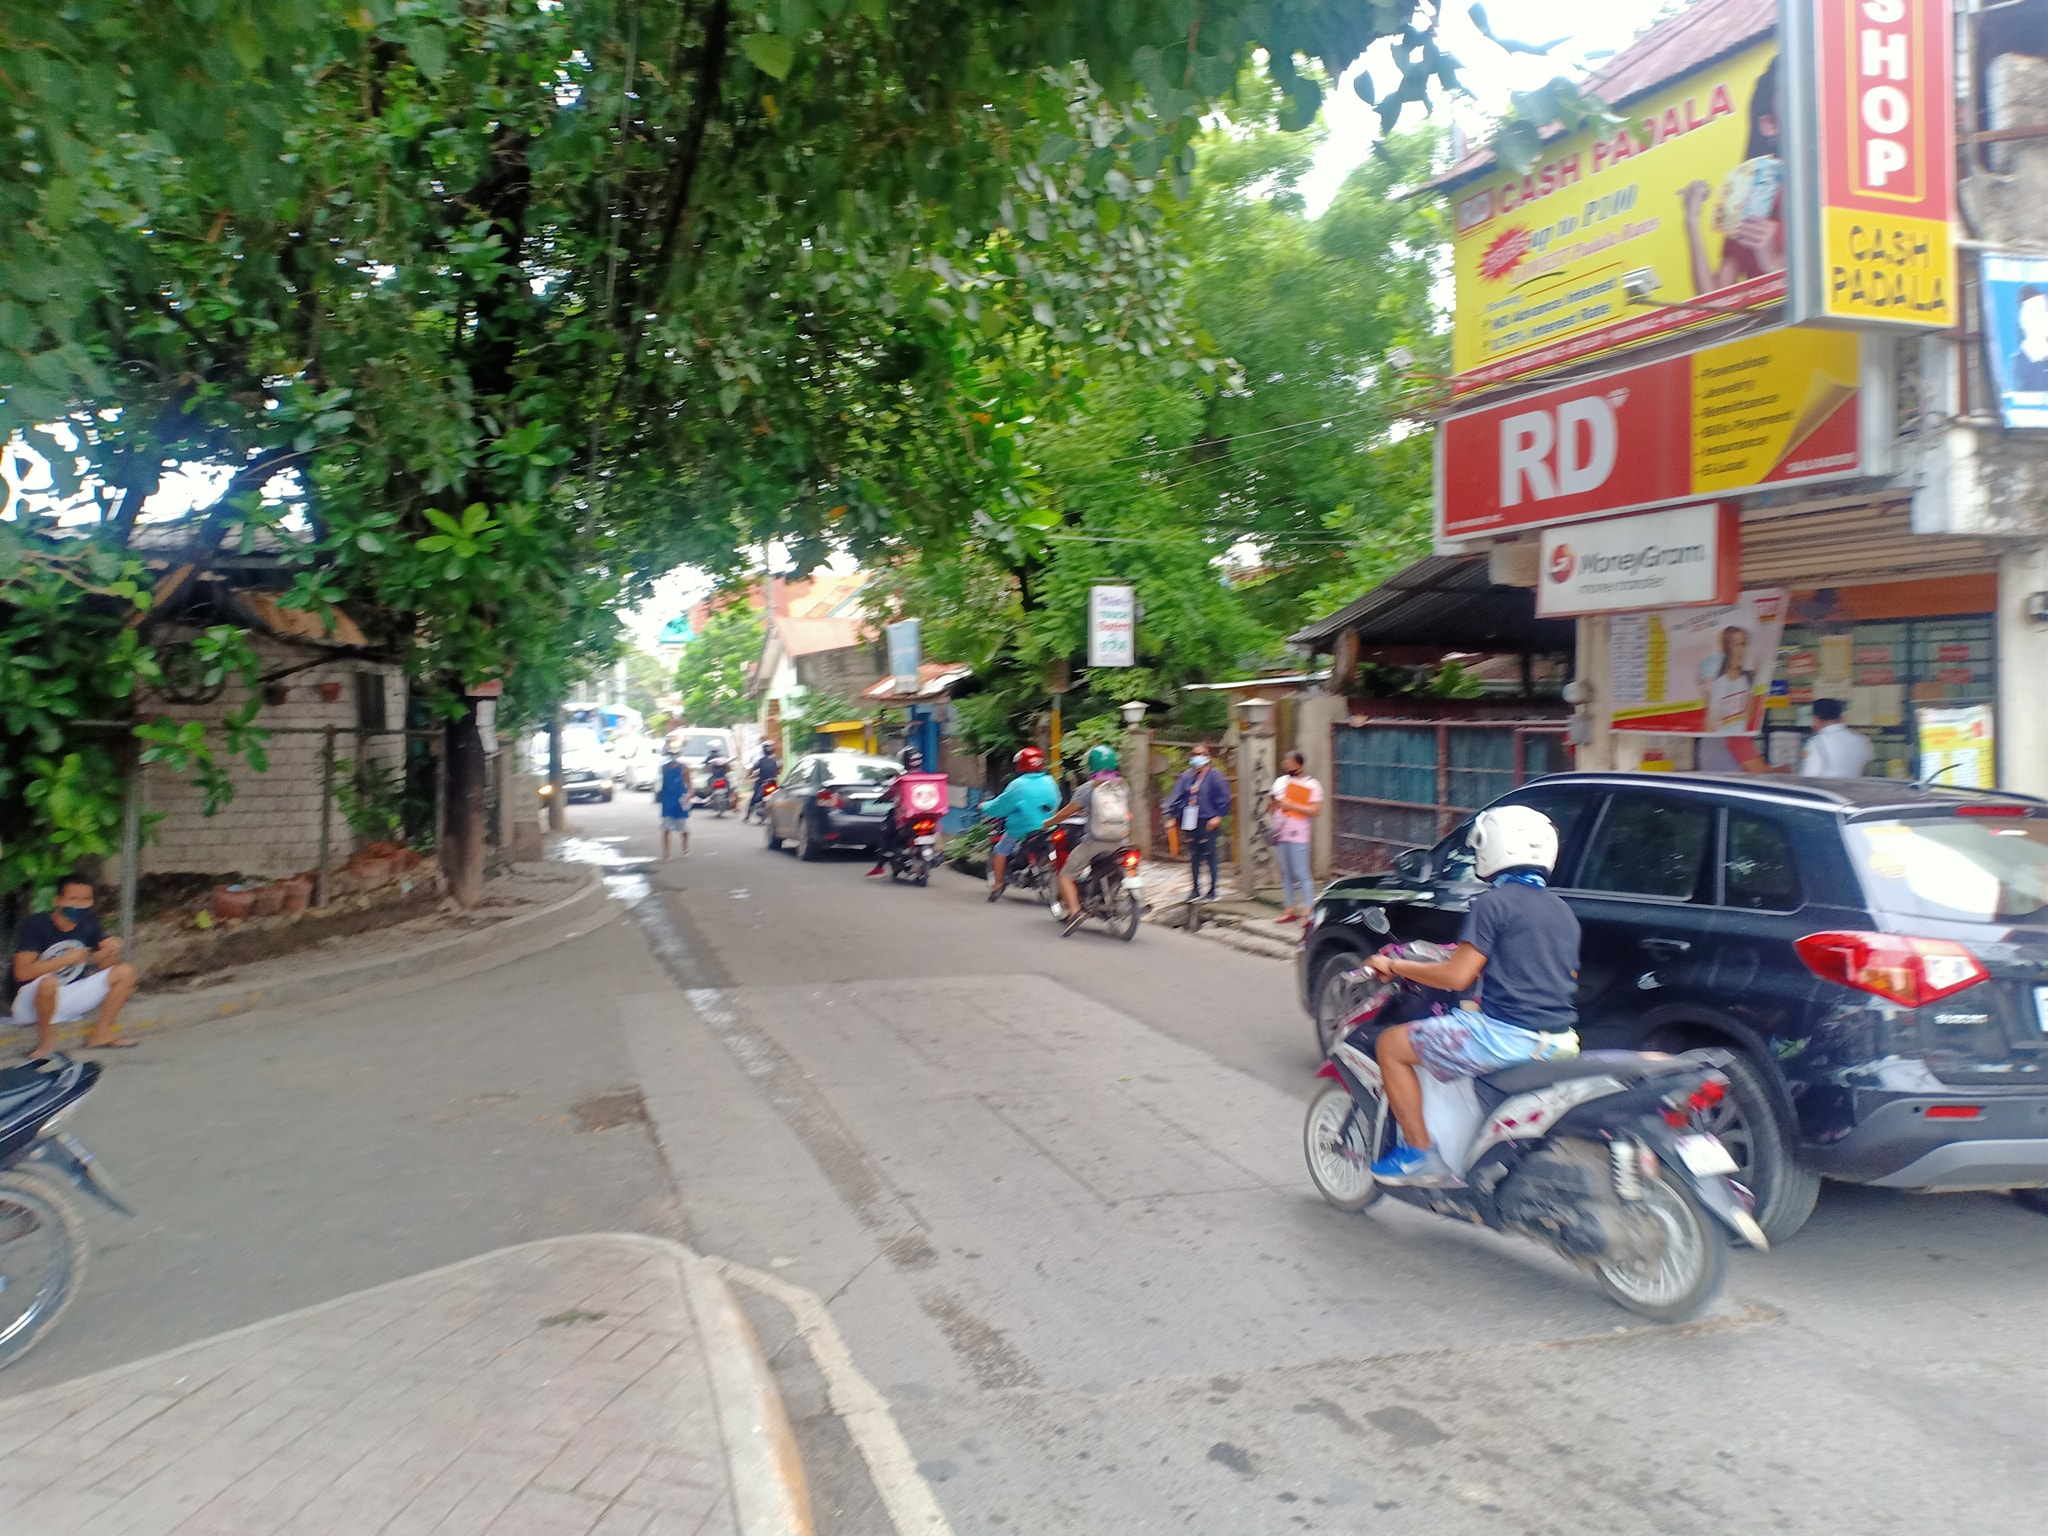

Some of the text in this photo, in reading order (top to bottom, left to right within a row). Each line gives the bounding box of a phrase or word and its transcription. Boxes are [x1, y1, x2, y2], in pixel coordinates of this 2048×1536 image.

[1502, 153, 1581, 214] CASH
[1848, 225, 1931, 269] CASH
[1832, 267, 1947, 312] PADALA
[1501, 396, 1618, 508] RD
[1578, 544, 1705, 576] MoneyGram
